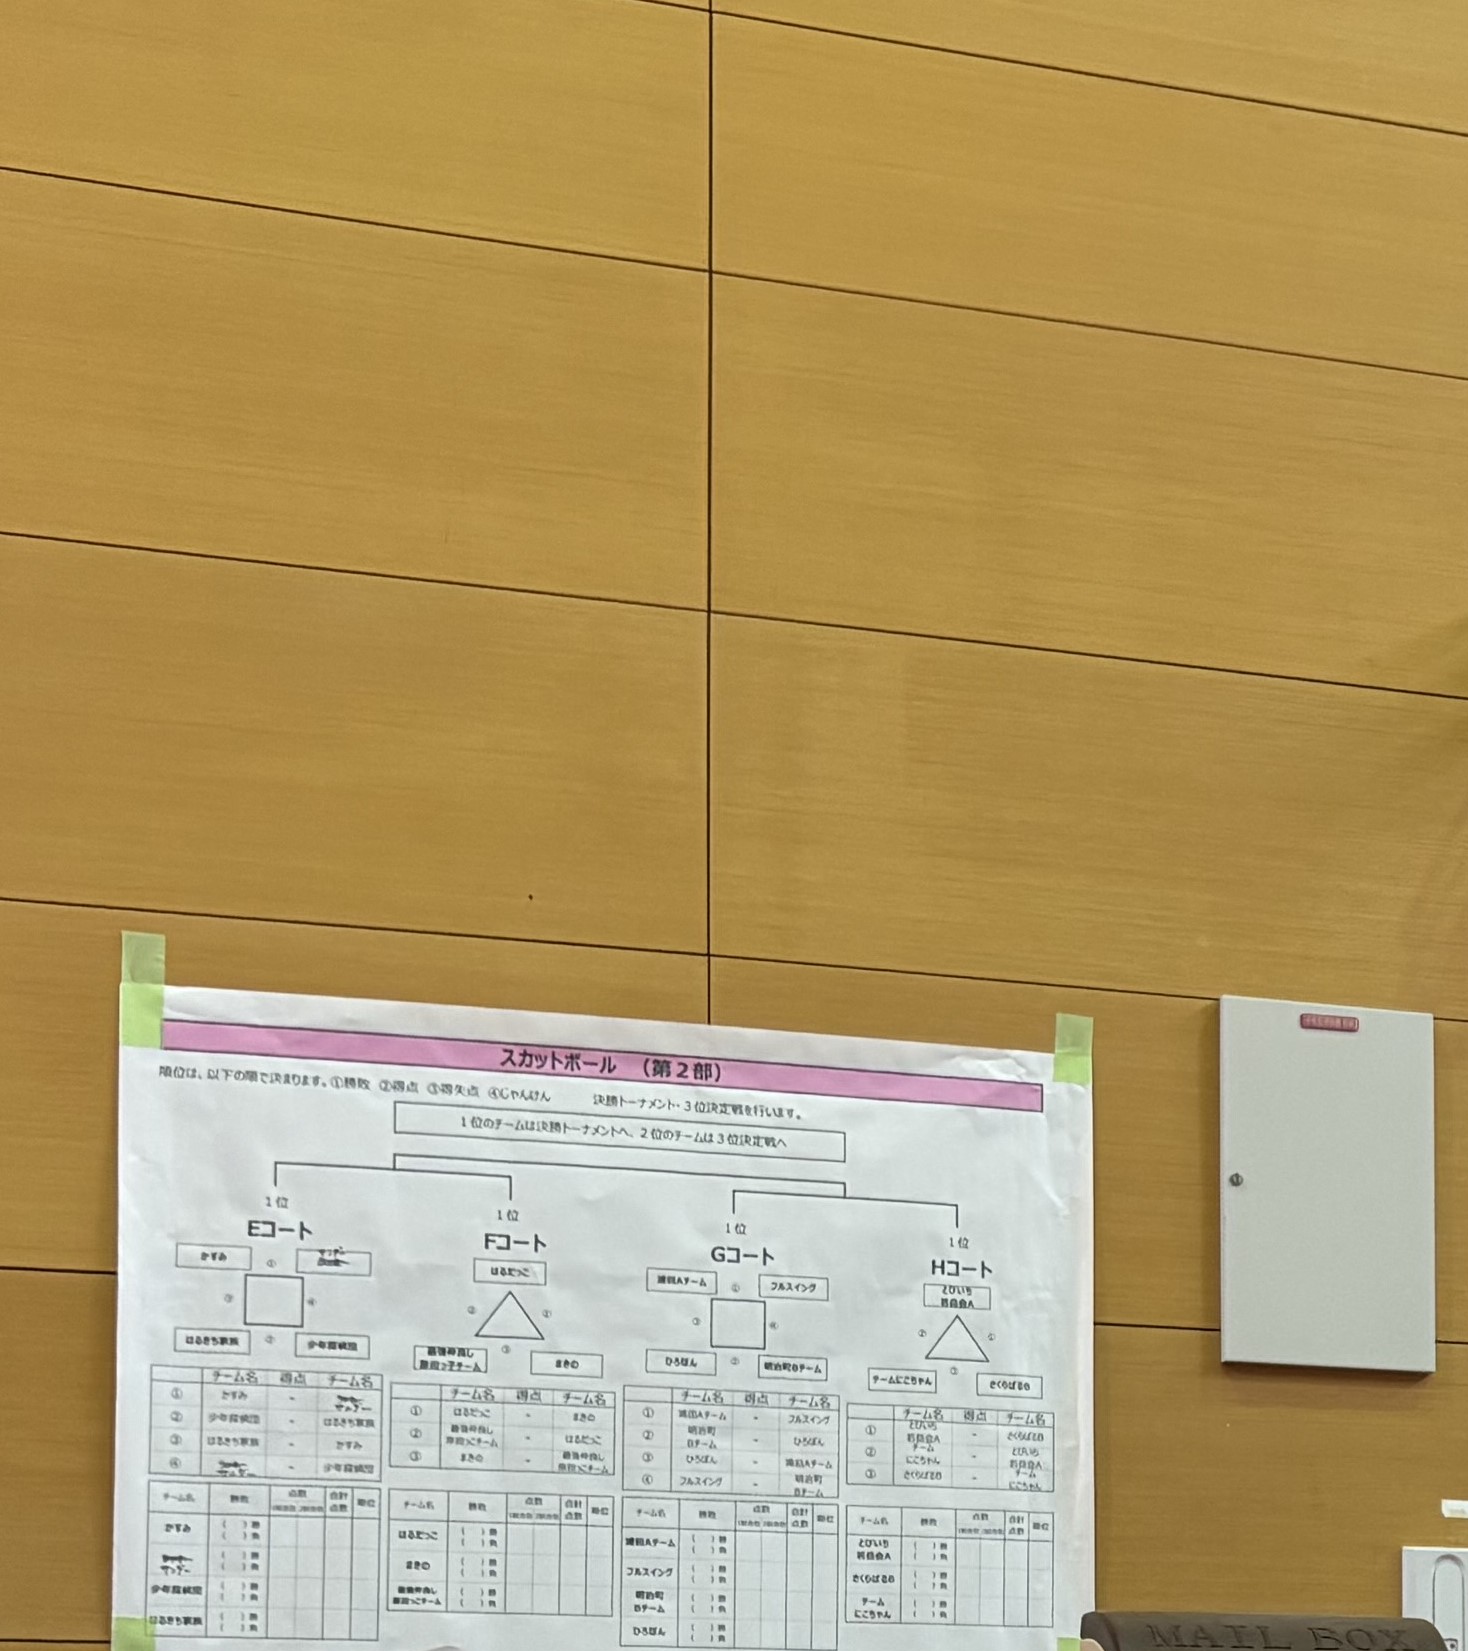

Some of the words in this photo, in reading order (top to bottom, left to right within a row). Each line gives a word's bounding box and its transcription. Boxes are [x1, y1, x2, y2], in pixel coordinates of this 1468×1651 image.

[500, 1047, 616, 1076] スカットボール
[247, 1219, 313, 1241] Eコート
[484, 1232, 548, 1253] Fコート
[710, 1245, 776, 1267] Gコート
[931, 1258, 994, 1279] Hコート
[770, 1280, 818, 1294] フルスイング
[787, 1414, 831, 1426] フルスイング
[679, 1475, 724, 1487] フルスイング
[625, 1566, 674, 1579] フルスイング
[1146, 1623, 1292, 1650] MAIL
